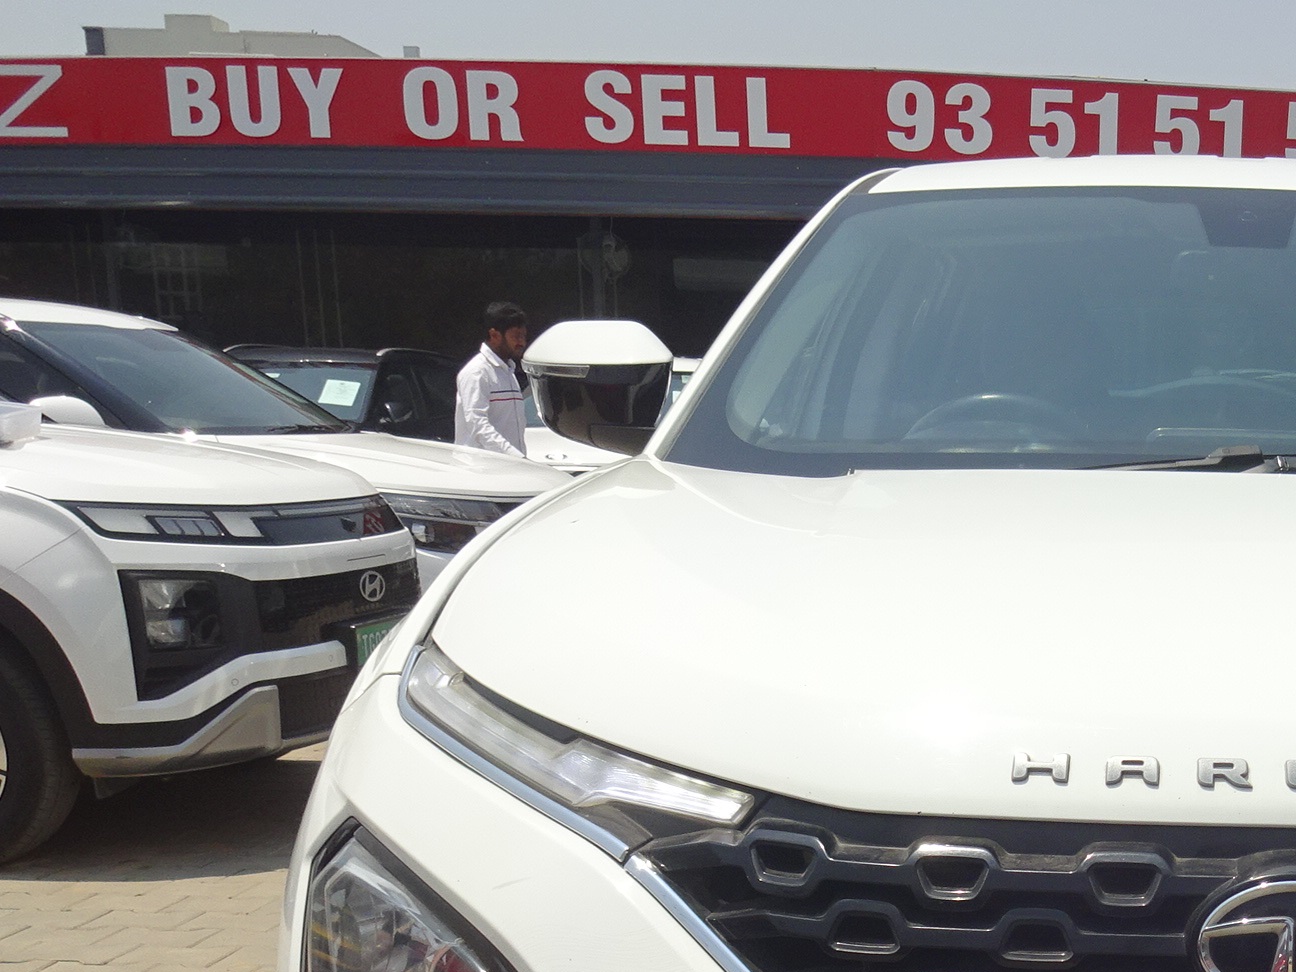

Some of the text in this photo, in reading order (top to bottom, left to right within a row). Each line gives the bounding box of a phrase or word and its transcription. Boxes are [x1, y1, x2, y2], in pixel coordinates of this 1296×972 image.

[164, 65, 343, 138] BUY
[403, 66, 524, 142] OR
[584, 70, 791, 149] SELL
[886, 80, 993, 155] 93
[1028, 88, 1119, 158] 51
[1153, 94, 1245, 158] 51
